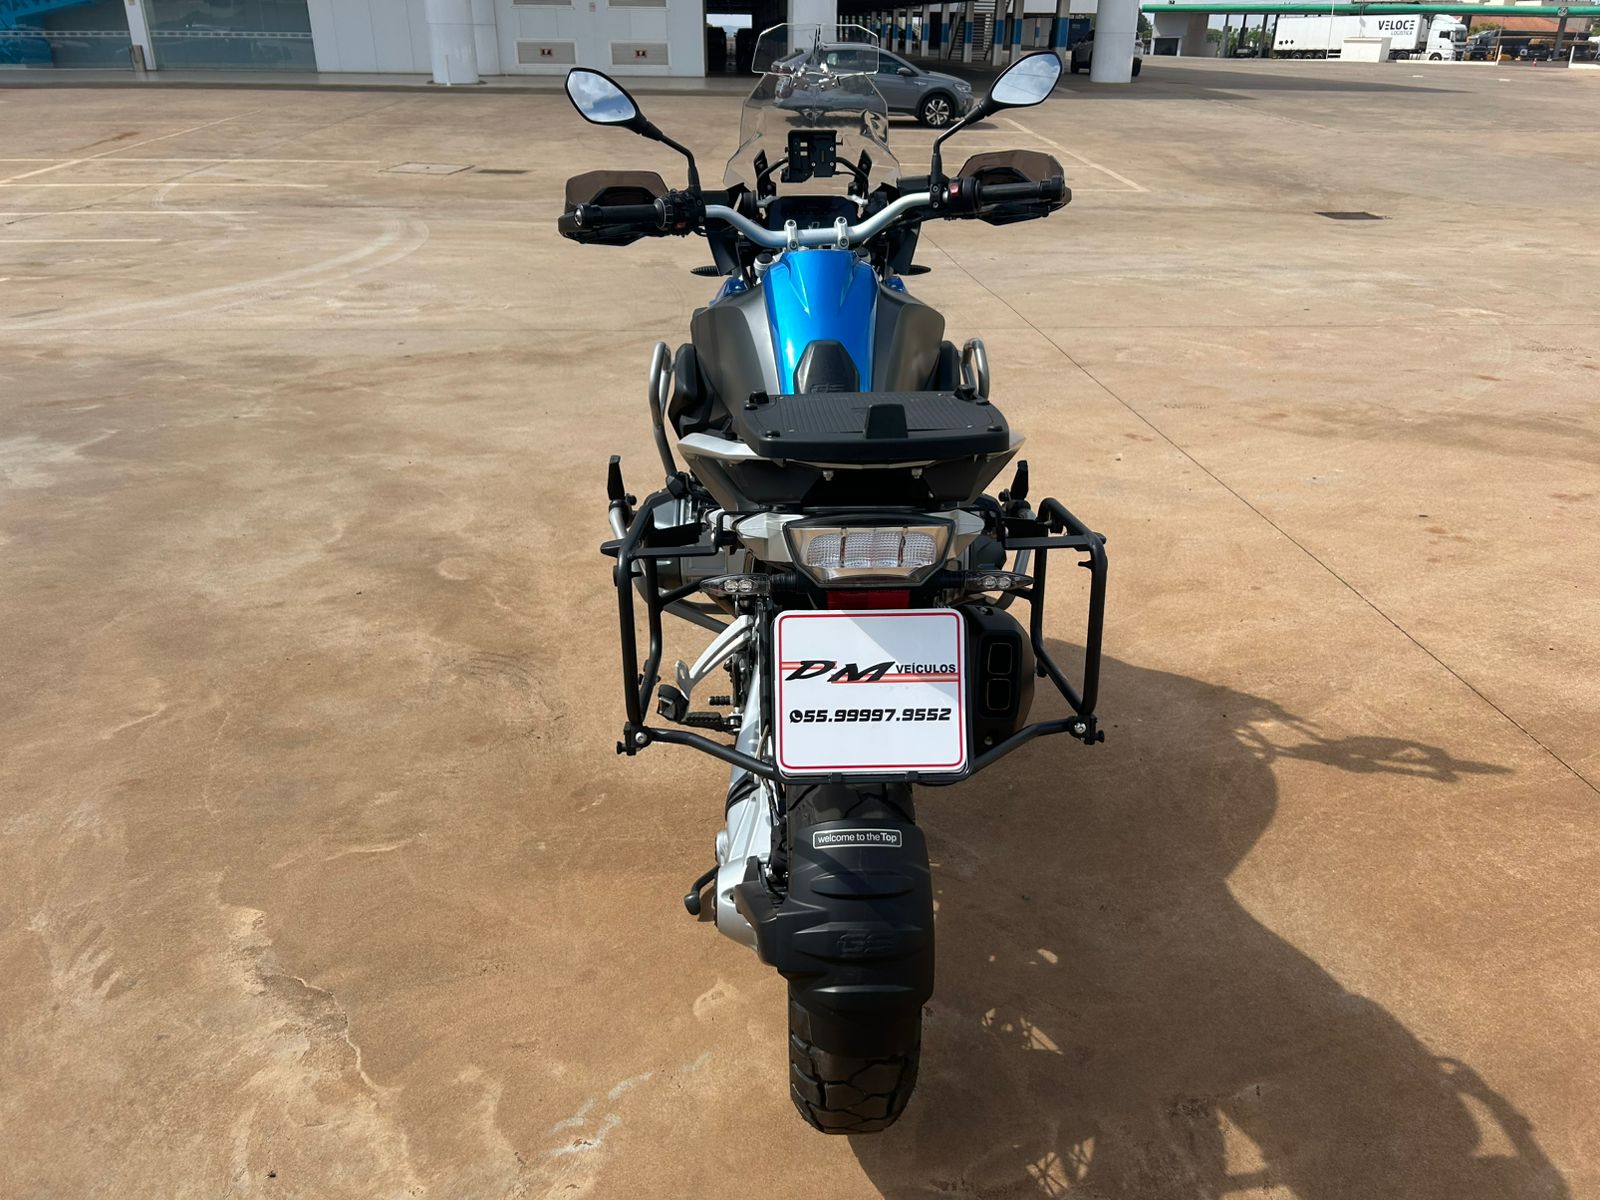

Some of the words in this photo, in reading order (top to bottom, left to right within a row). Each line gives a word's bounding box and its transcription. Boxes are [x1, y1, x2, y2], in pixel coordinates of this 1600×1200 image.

[1378, 20, 1415, 30] VELOCE
[785, 660, 896, 683] DM
[896, 662, 956, 674] VEÍCULOS
[803, 708, 952, 723] 55.99997.9552
[817, 833, 855, 844] welcome
[856, 832, 865, 841] to
[866, 832, 880, 841] the
[880, 832, 897, 844] Top
